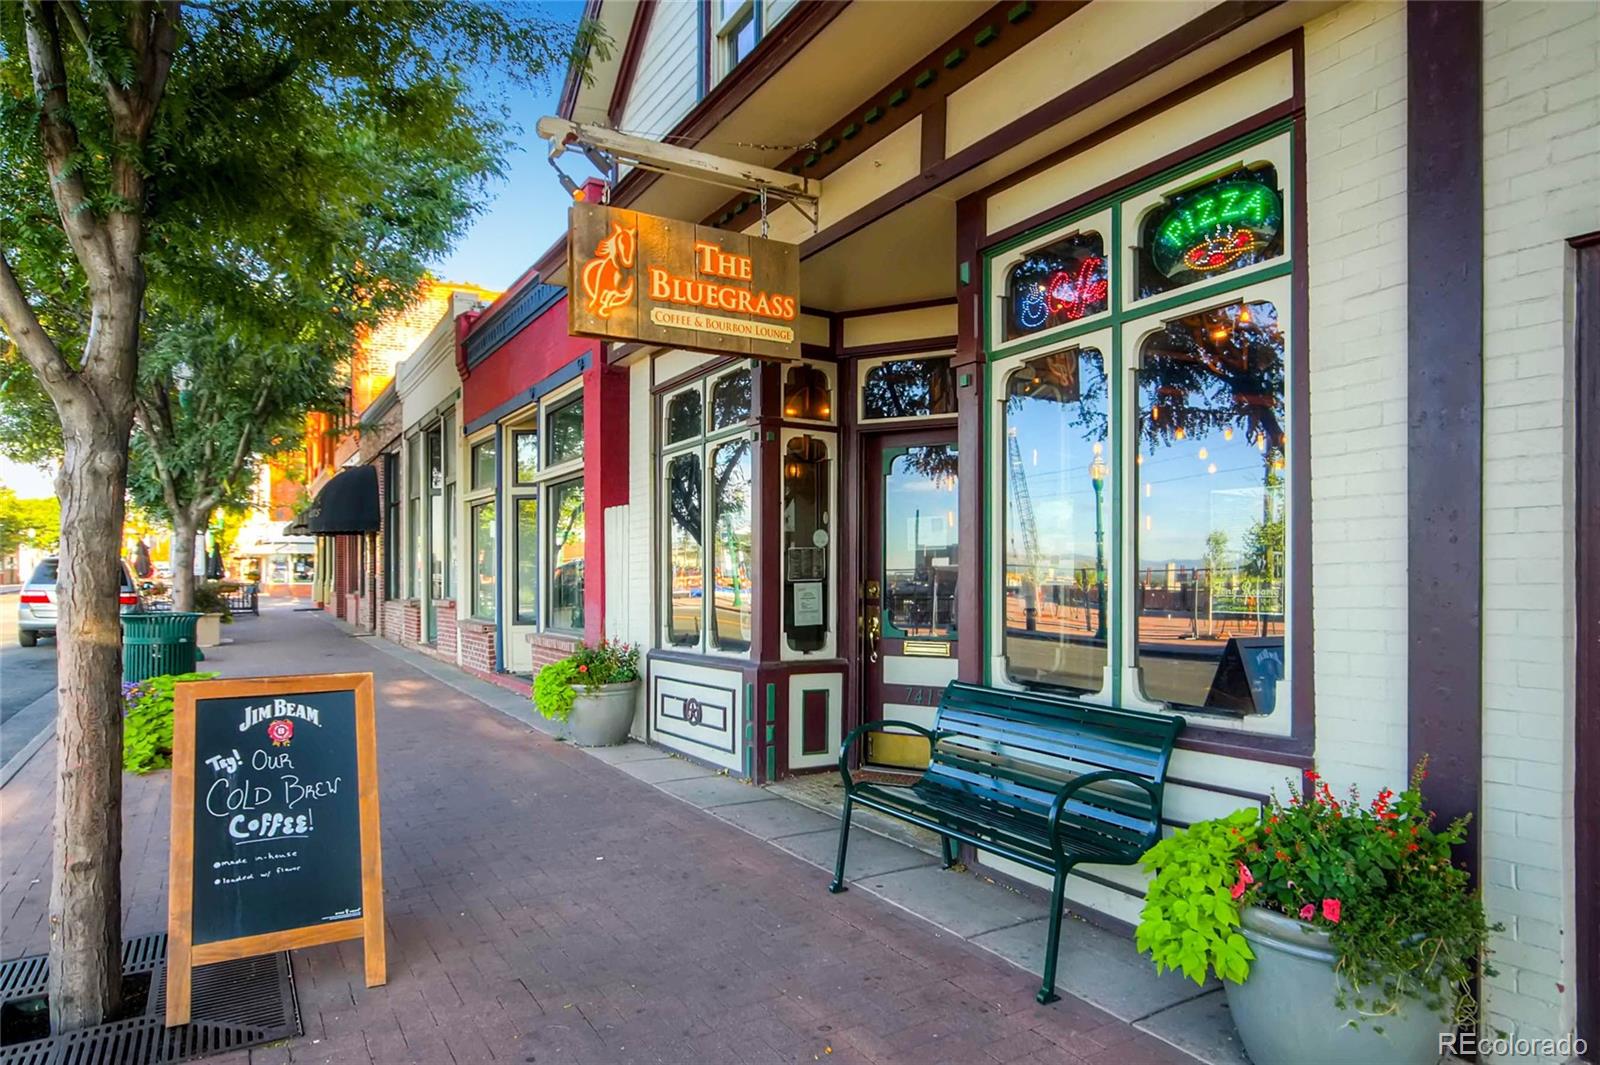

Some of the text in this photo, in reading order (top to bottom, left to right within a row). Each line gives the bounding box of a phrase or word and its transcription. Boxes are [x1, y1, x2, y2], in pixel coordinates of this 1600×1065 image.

[1166, 190, 1261, 246] PIZZA
[697, 244, 752, 279] THE
[651, 268, 794, 318] BLUEGRASS
[655, 310, 792, 340] COFFEE & BOURBON LOUNGE
[239, 699, 320, 731] JIM BEAM
[206, 775, 341, 817] COLD BREW
